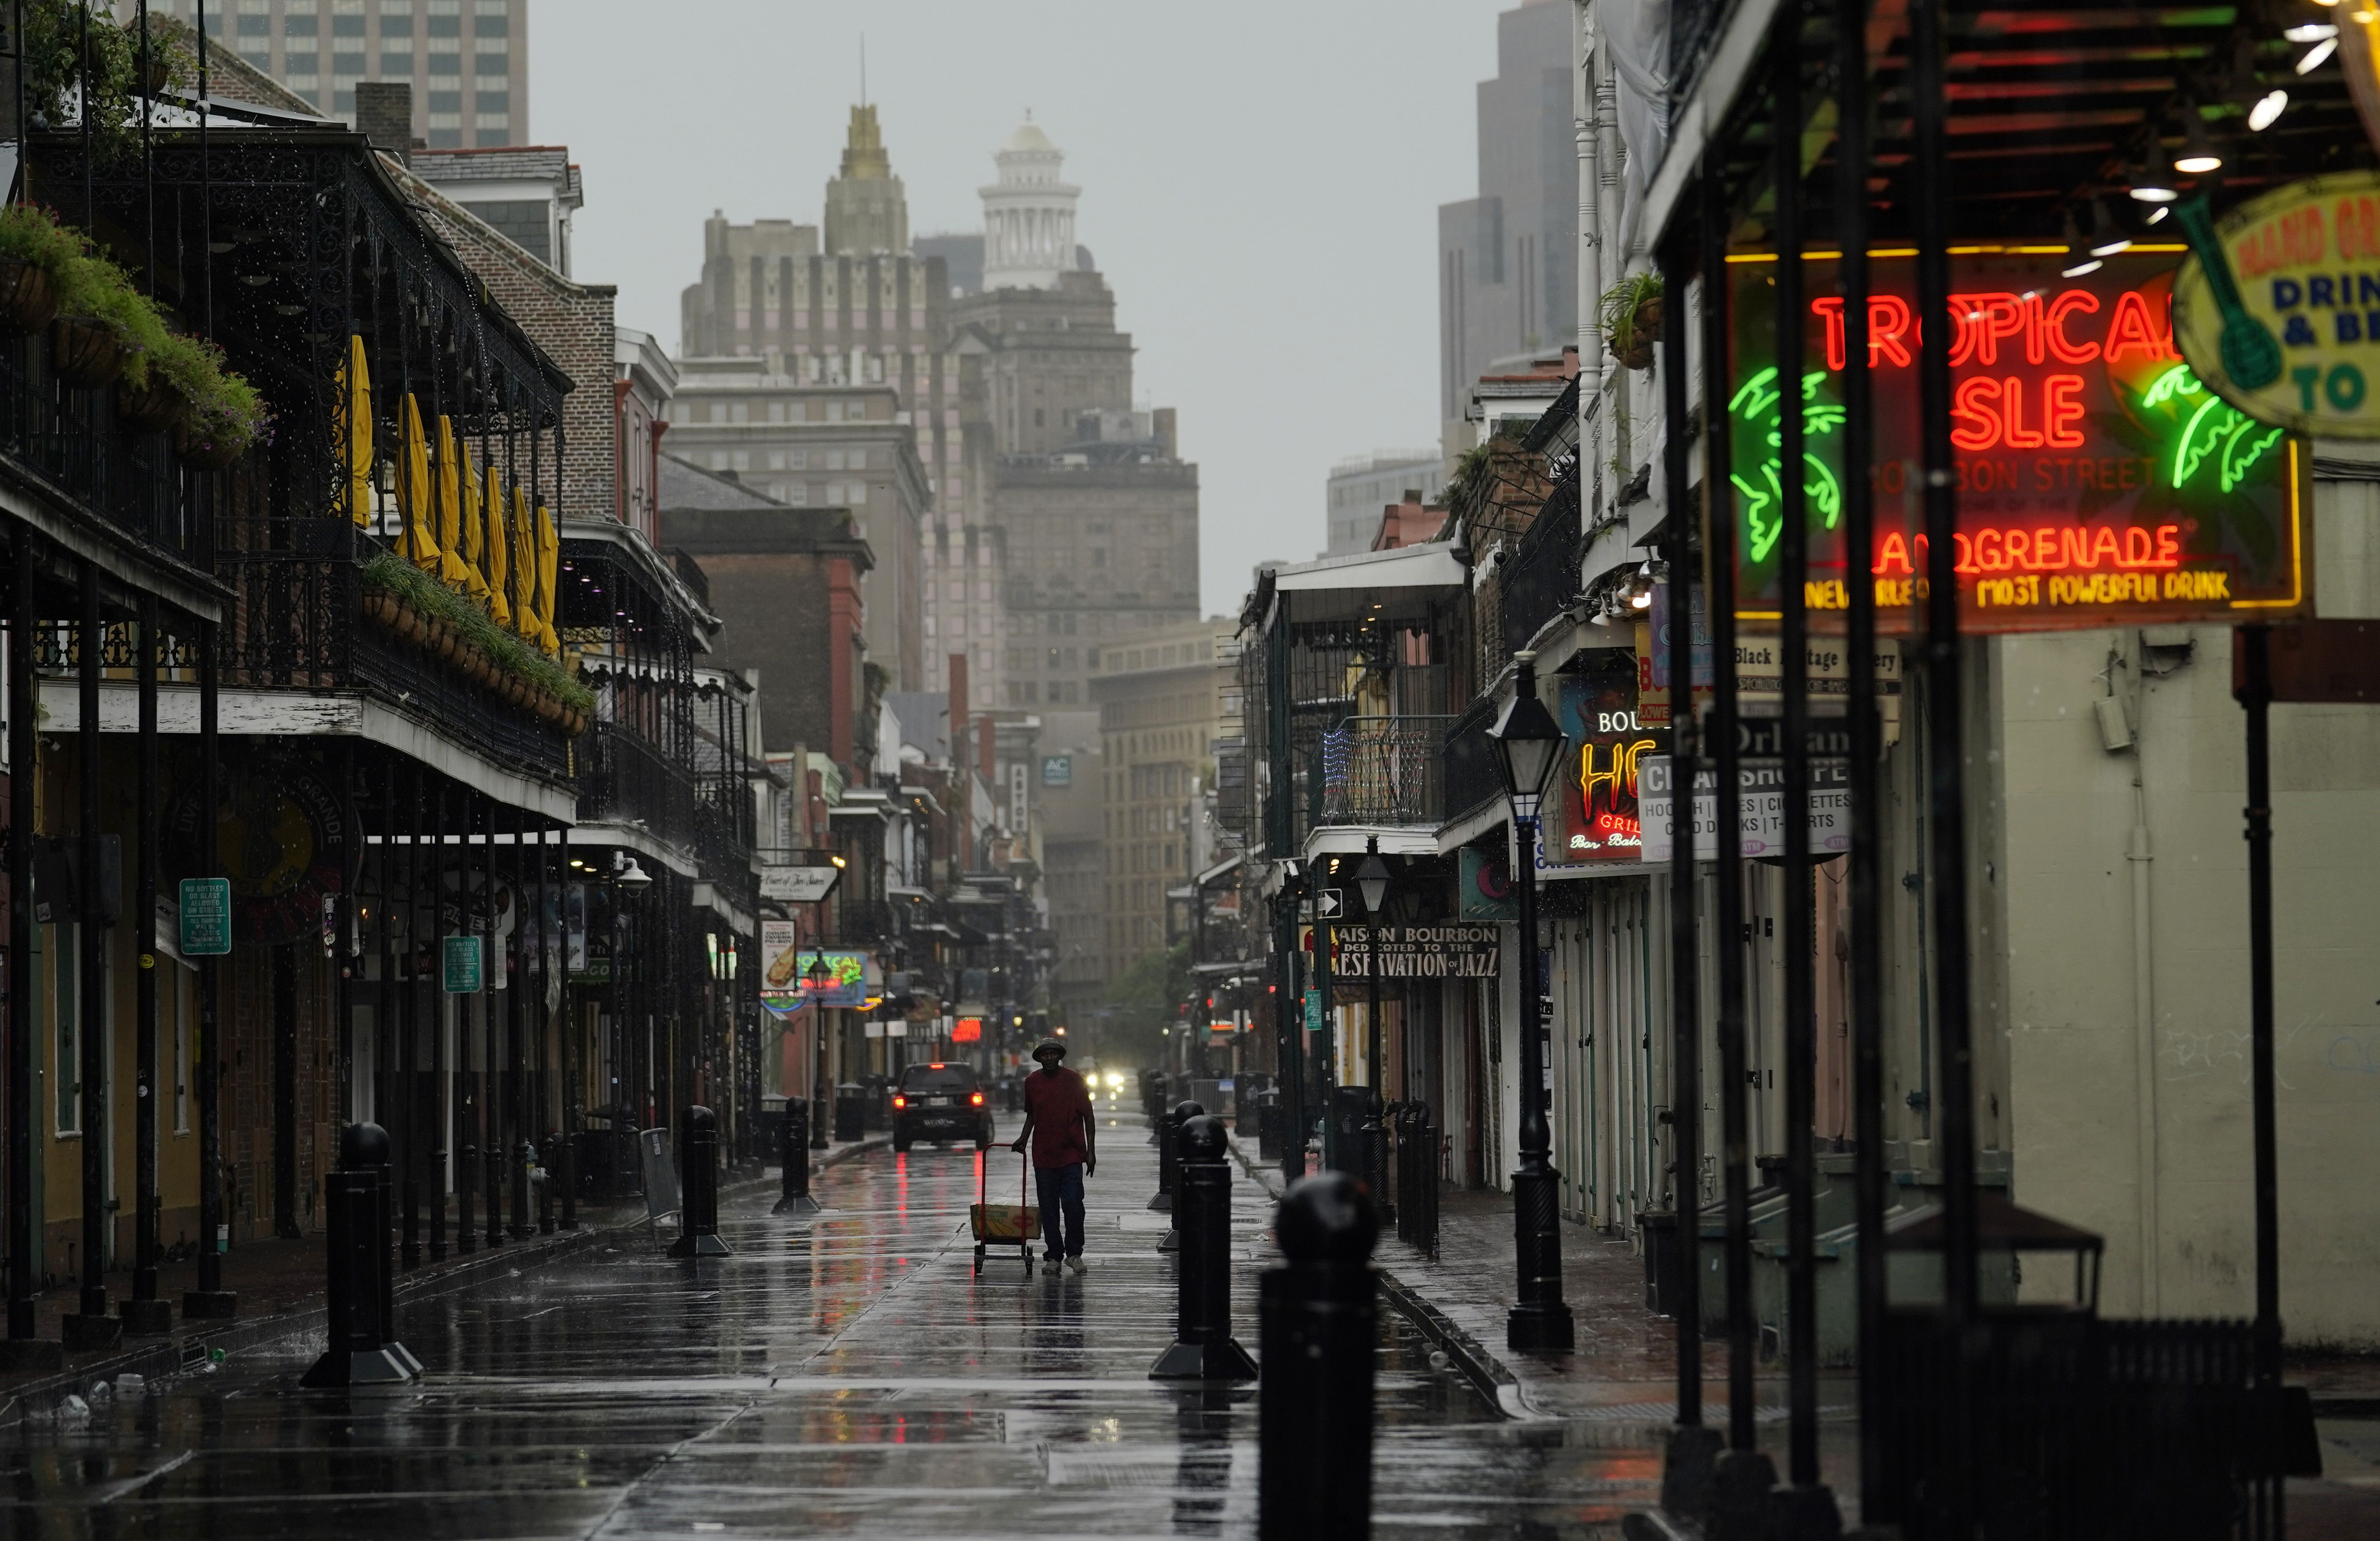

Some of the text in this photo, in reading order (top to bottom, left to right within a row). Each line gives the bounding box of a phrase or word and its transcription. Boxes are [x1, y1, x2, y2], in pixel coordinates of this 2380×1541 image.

[2334, 194, 2380, 260] GR
[2272, 274, 2380, 311] DRIN
[2282, 310, 2380, 345] & BE
[2291, 362, 2367, 413] TO
[1950, 374, 2085, 451] SLE
[1871, 455, 2158, 495] OBON STREET
[1974, 525, 2180, 571] GRENADE
[2048, 572, 2160, 607] POWERFUL
[2164, 570, 2230, 601] DRINK
[1735, 648, 1771, 664] Black
[298, 775, 343, 844] GRANDE
[1600, 814, 1642, 834] GRIL
[1570, 835, 1601, 849] Bar
[1344, 943, 1474, 952] DEDCATED TO THE
[1405, 927, 1497, 943] BOURBON
[1333, 952, 1448, 977] ESERVATION
[1455, 947, 1498, 977] JAZZ
